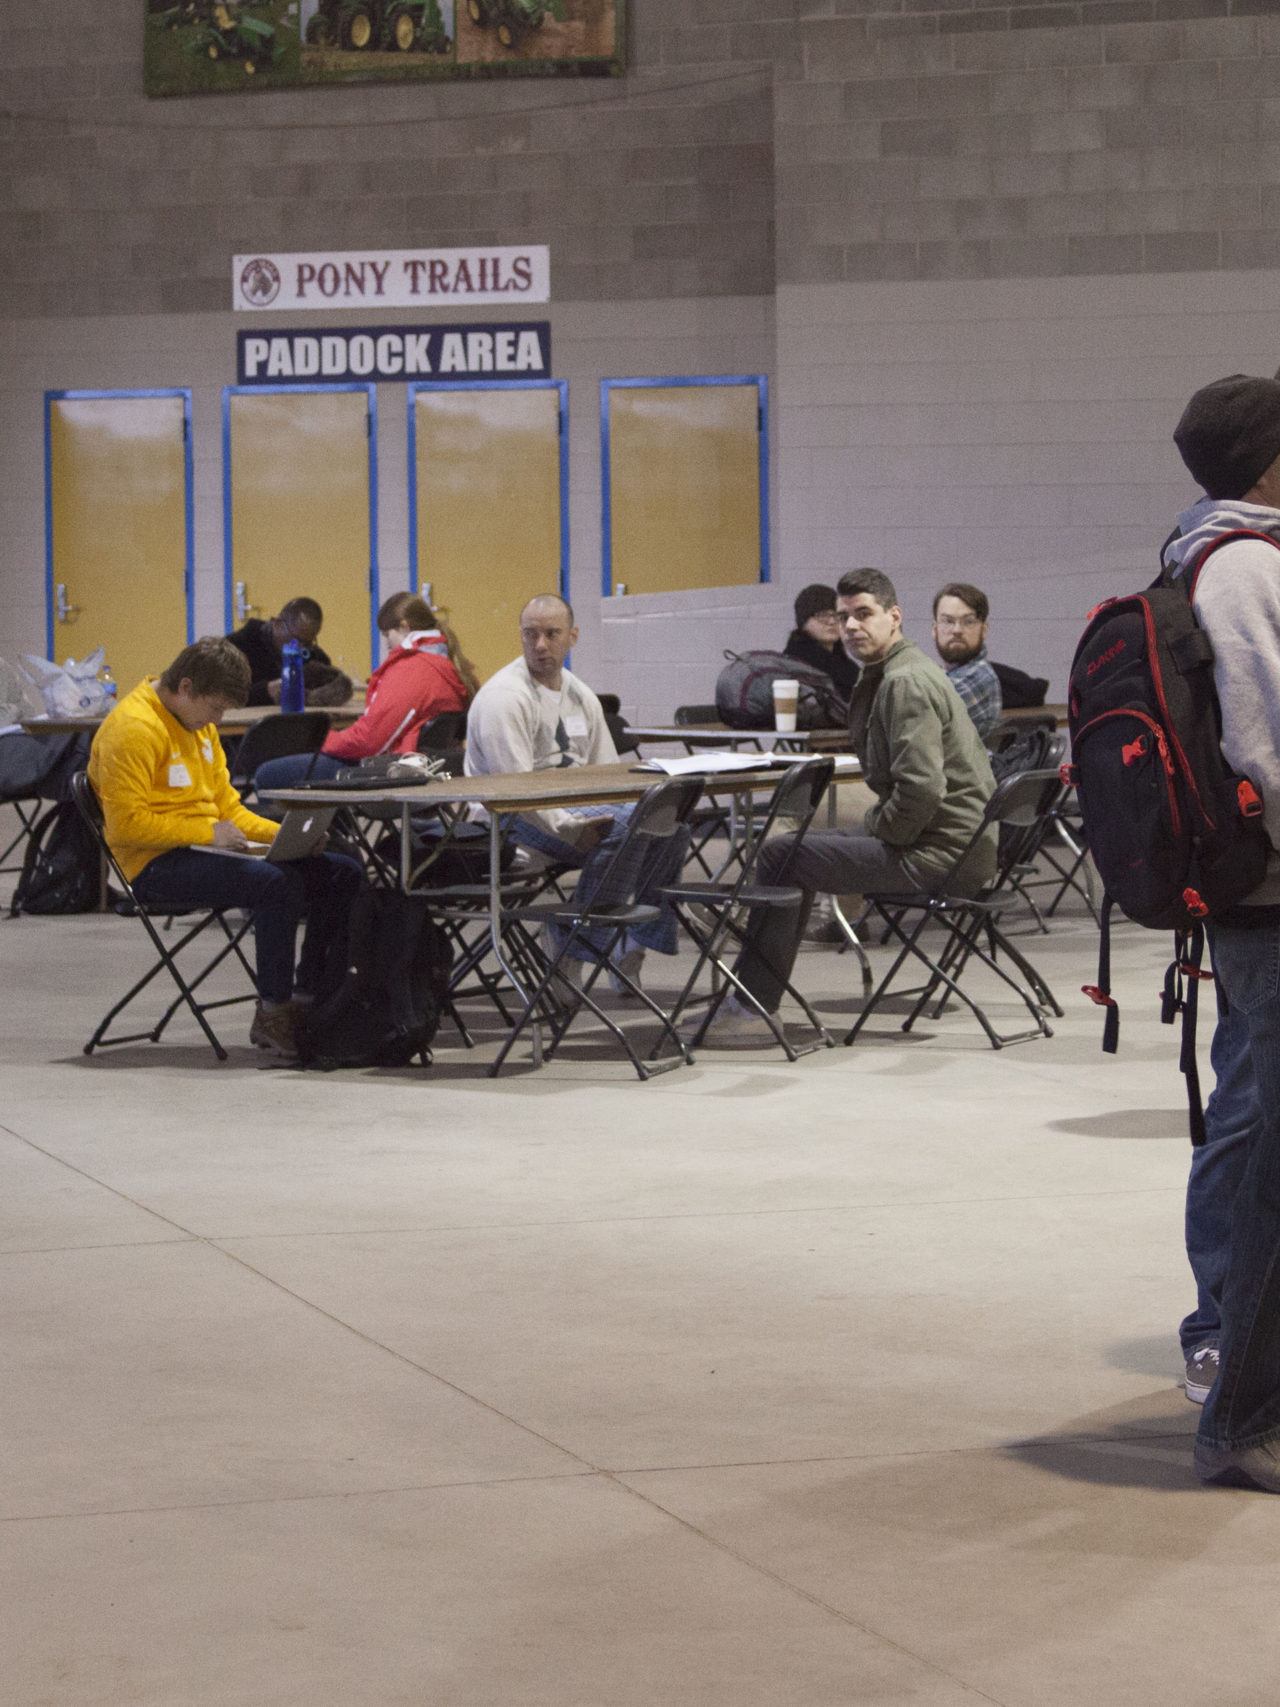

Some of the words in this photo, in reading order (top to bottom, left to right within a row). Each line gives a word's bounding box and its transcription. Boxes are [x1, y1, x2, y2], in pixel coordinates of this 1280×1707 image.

[296, 260, 391, 297] PONY
[403, 256, 533, 294] TRAILS
[244, 333, 433, 377] PADDOCK
[438, 330, 544, 373] AREA
